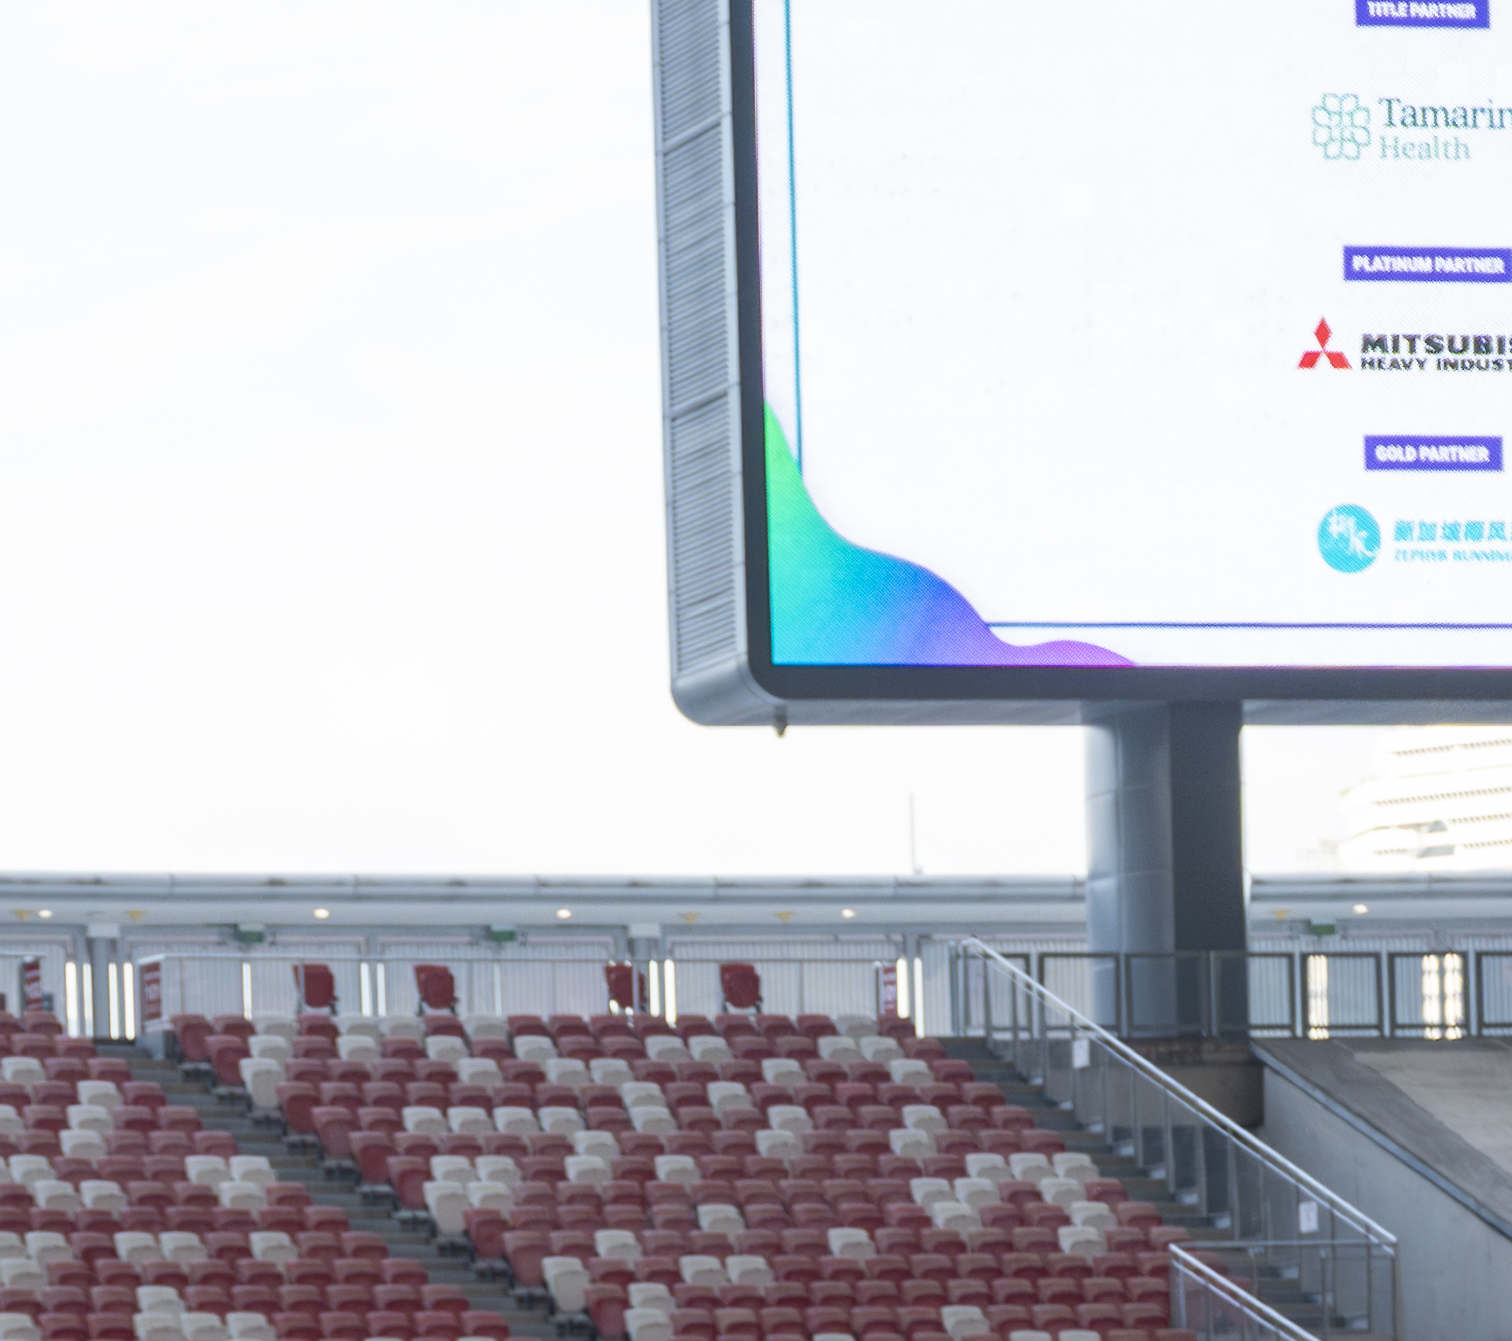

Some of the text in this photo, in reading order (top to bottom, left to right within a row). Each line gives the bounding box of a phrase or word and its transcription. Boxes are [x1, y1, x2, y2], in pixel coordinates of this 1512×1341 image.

[1367, 1, 1477, 19] TITLE PARTNER
[1379, 136, 1471, 160] Health
[1352, 254, 1505, 274] PLATINUM PARTNER
[1361, 357, 1427, 371] HEAVY
[1375, 444, 1491, 463] GOLD PARTNER
